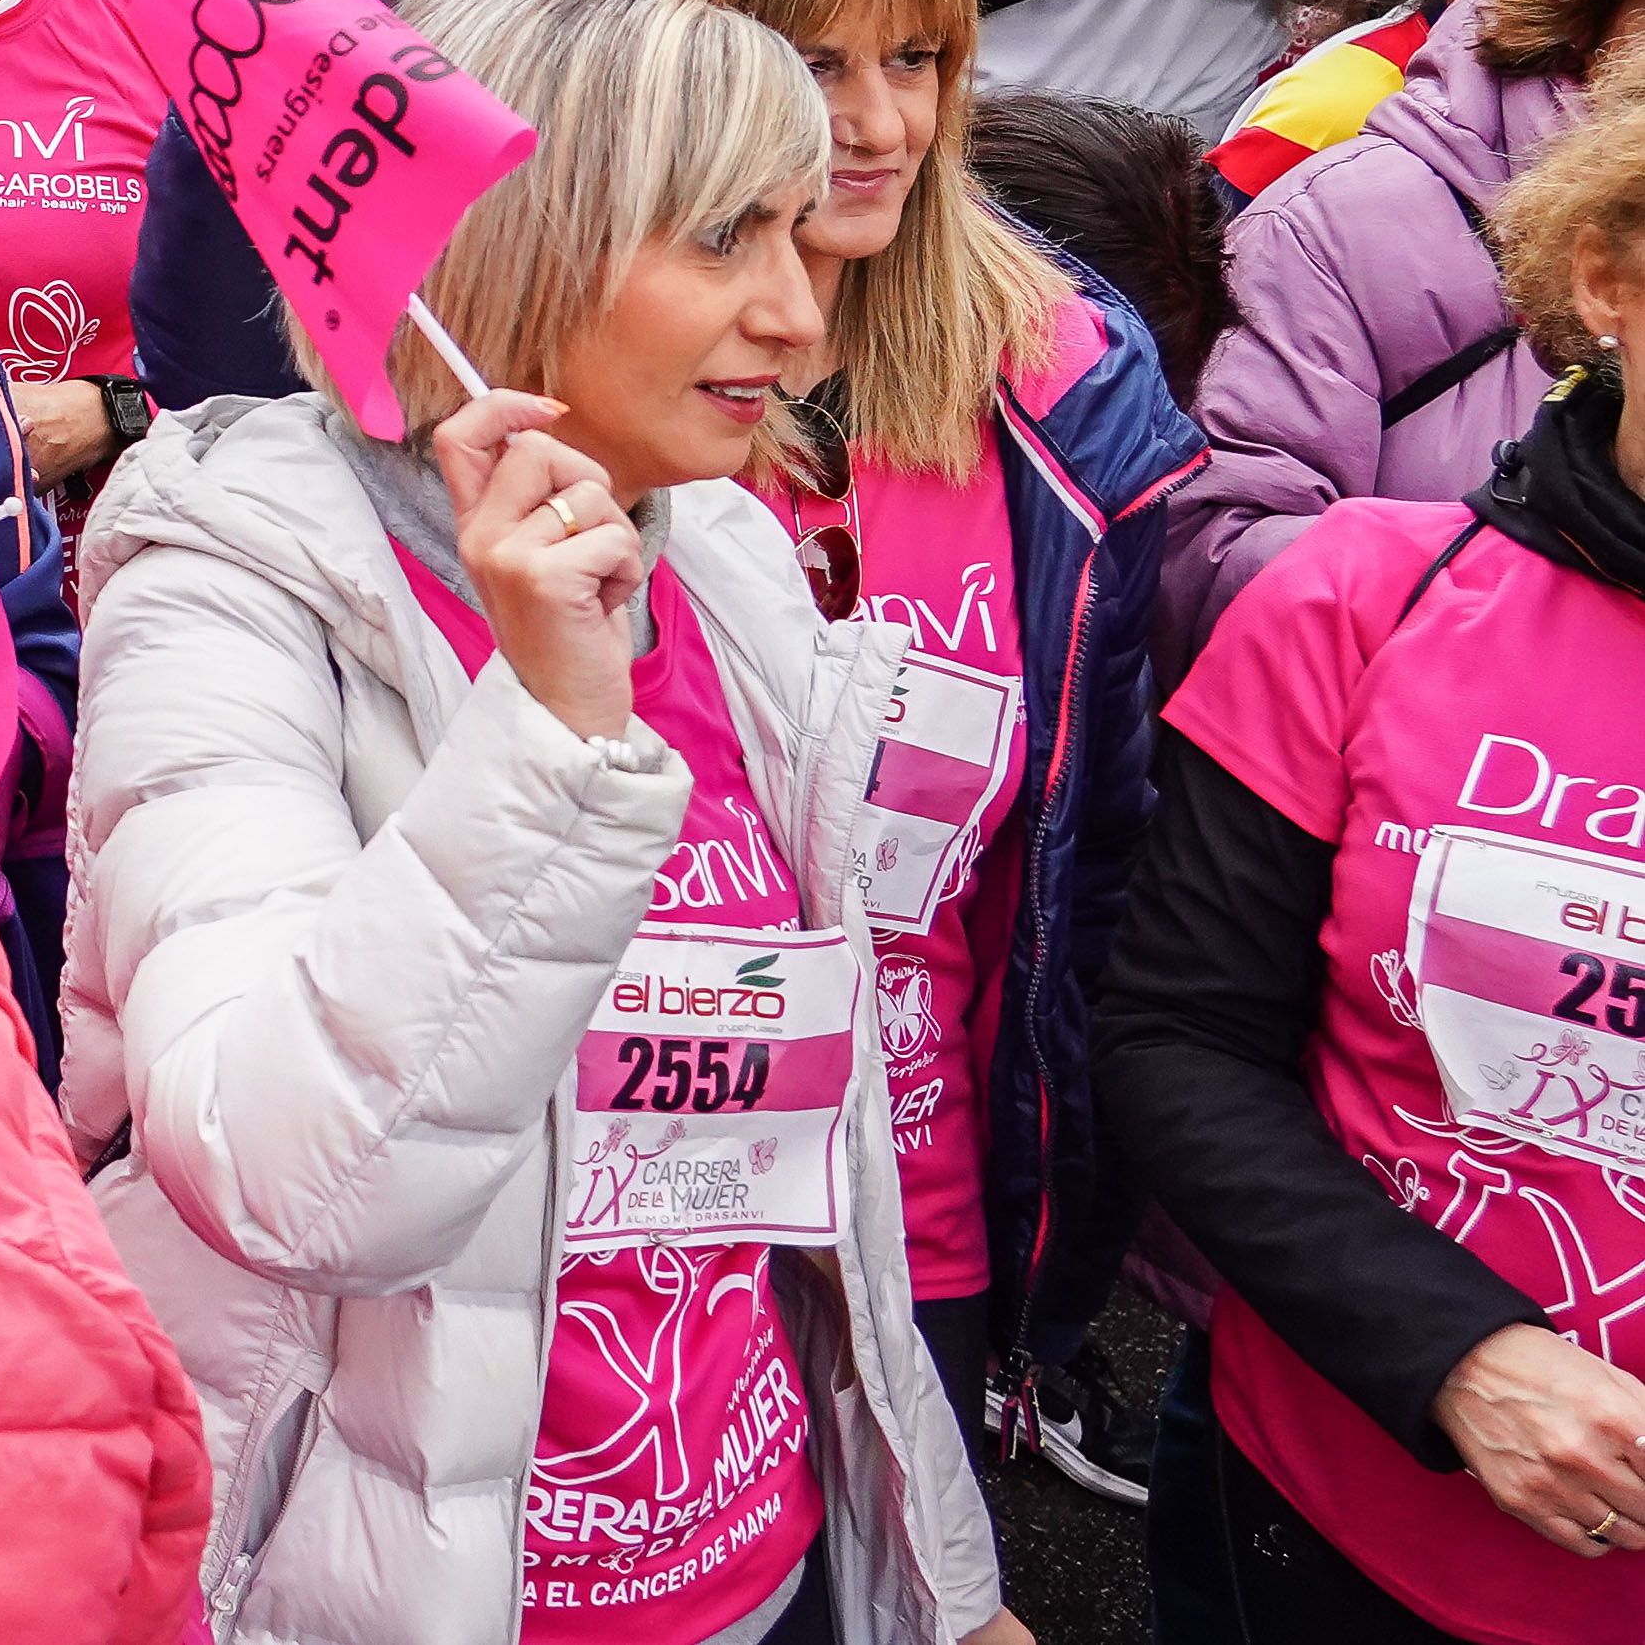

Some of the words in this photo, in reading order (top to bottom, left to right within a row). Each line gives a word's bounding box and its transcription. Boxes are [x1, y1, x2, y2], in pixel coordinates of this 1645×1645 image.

[256, 30, 358, 184] Designers
[283, 45, 457, 287] edent
[41, 198, 88, 213] beauty
[99, 201, 128, 216] style
[1559, 900, 1609, 935] el
[613, 975, 651, 1013] el
[659, 976, 786, 1020] bierzo
[610, 1036, 771, 1113] 2554
[643, 1159, 741, 1185] CARRERA
[628, 1191, 649, 1208] DE
[651, 1191, 665, 1208] LA
[671, 1183, 750, 1212] MUJER
[695, 1211, 764, 1223] DRASANVI
[713, 1357, 801, 1510] MUJER
[545, 1581, 582, 1607] EL
[590, 1558, 697, 1607] CÁNCER
[701, 1535, 727, 1574] DE
[728, 1492, 782, 1553] MAMA
